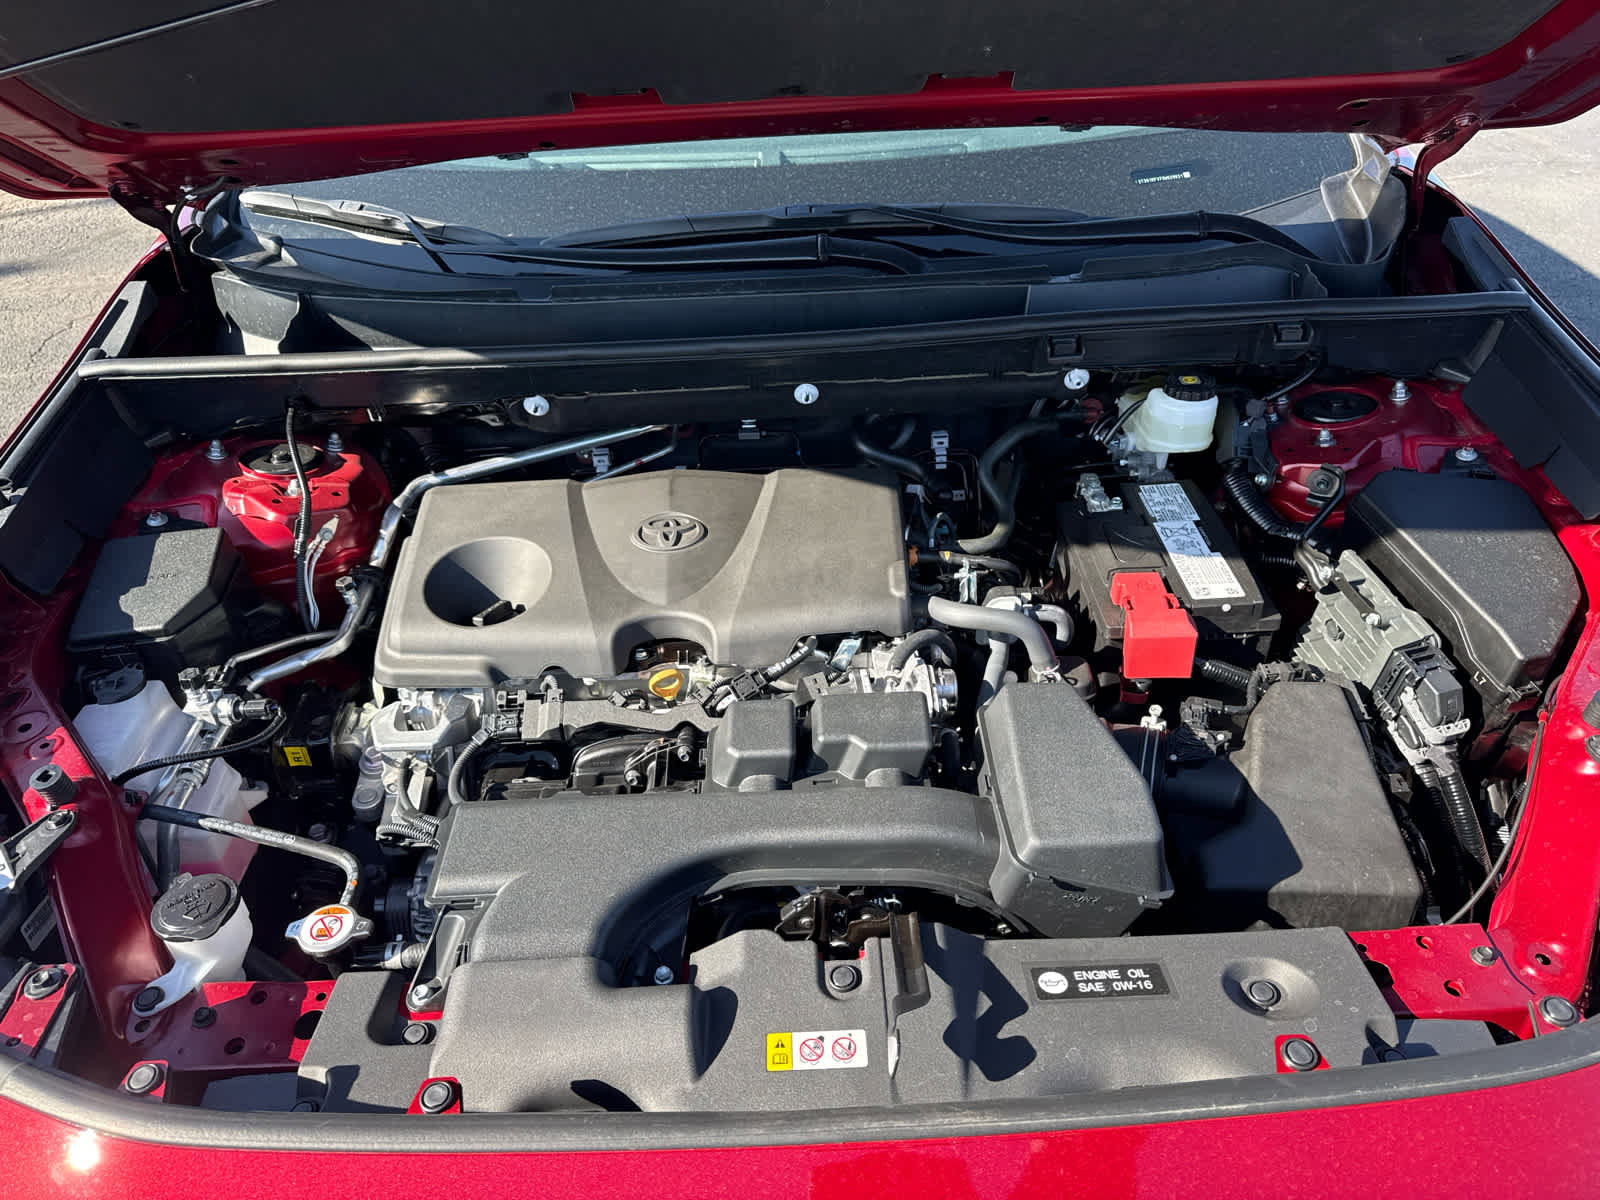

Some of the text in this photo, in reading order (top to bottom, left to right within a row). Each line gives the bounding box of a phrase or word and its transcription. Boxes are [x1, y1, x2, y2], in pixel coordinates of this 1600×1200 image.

[1073, 968, 1150, 981] ENGINE OIL
[1077, 980, 1153, 993] SAE 0W-16
